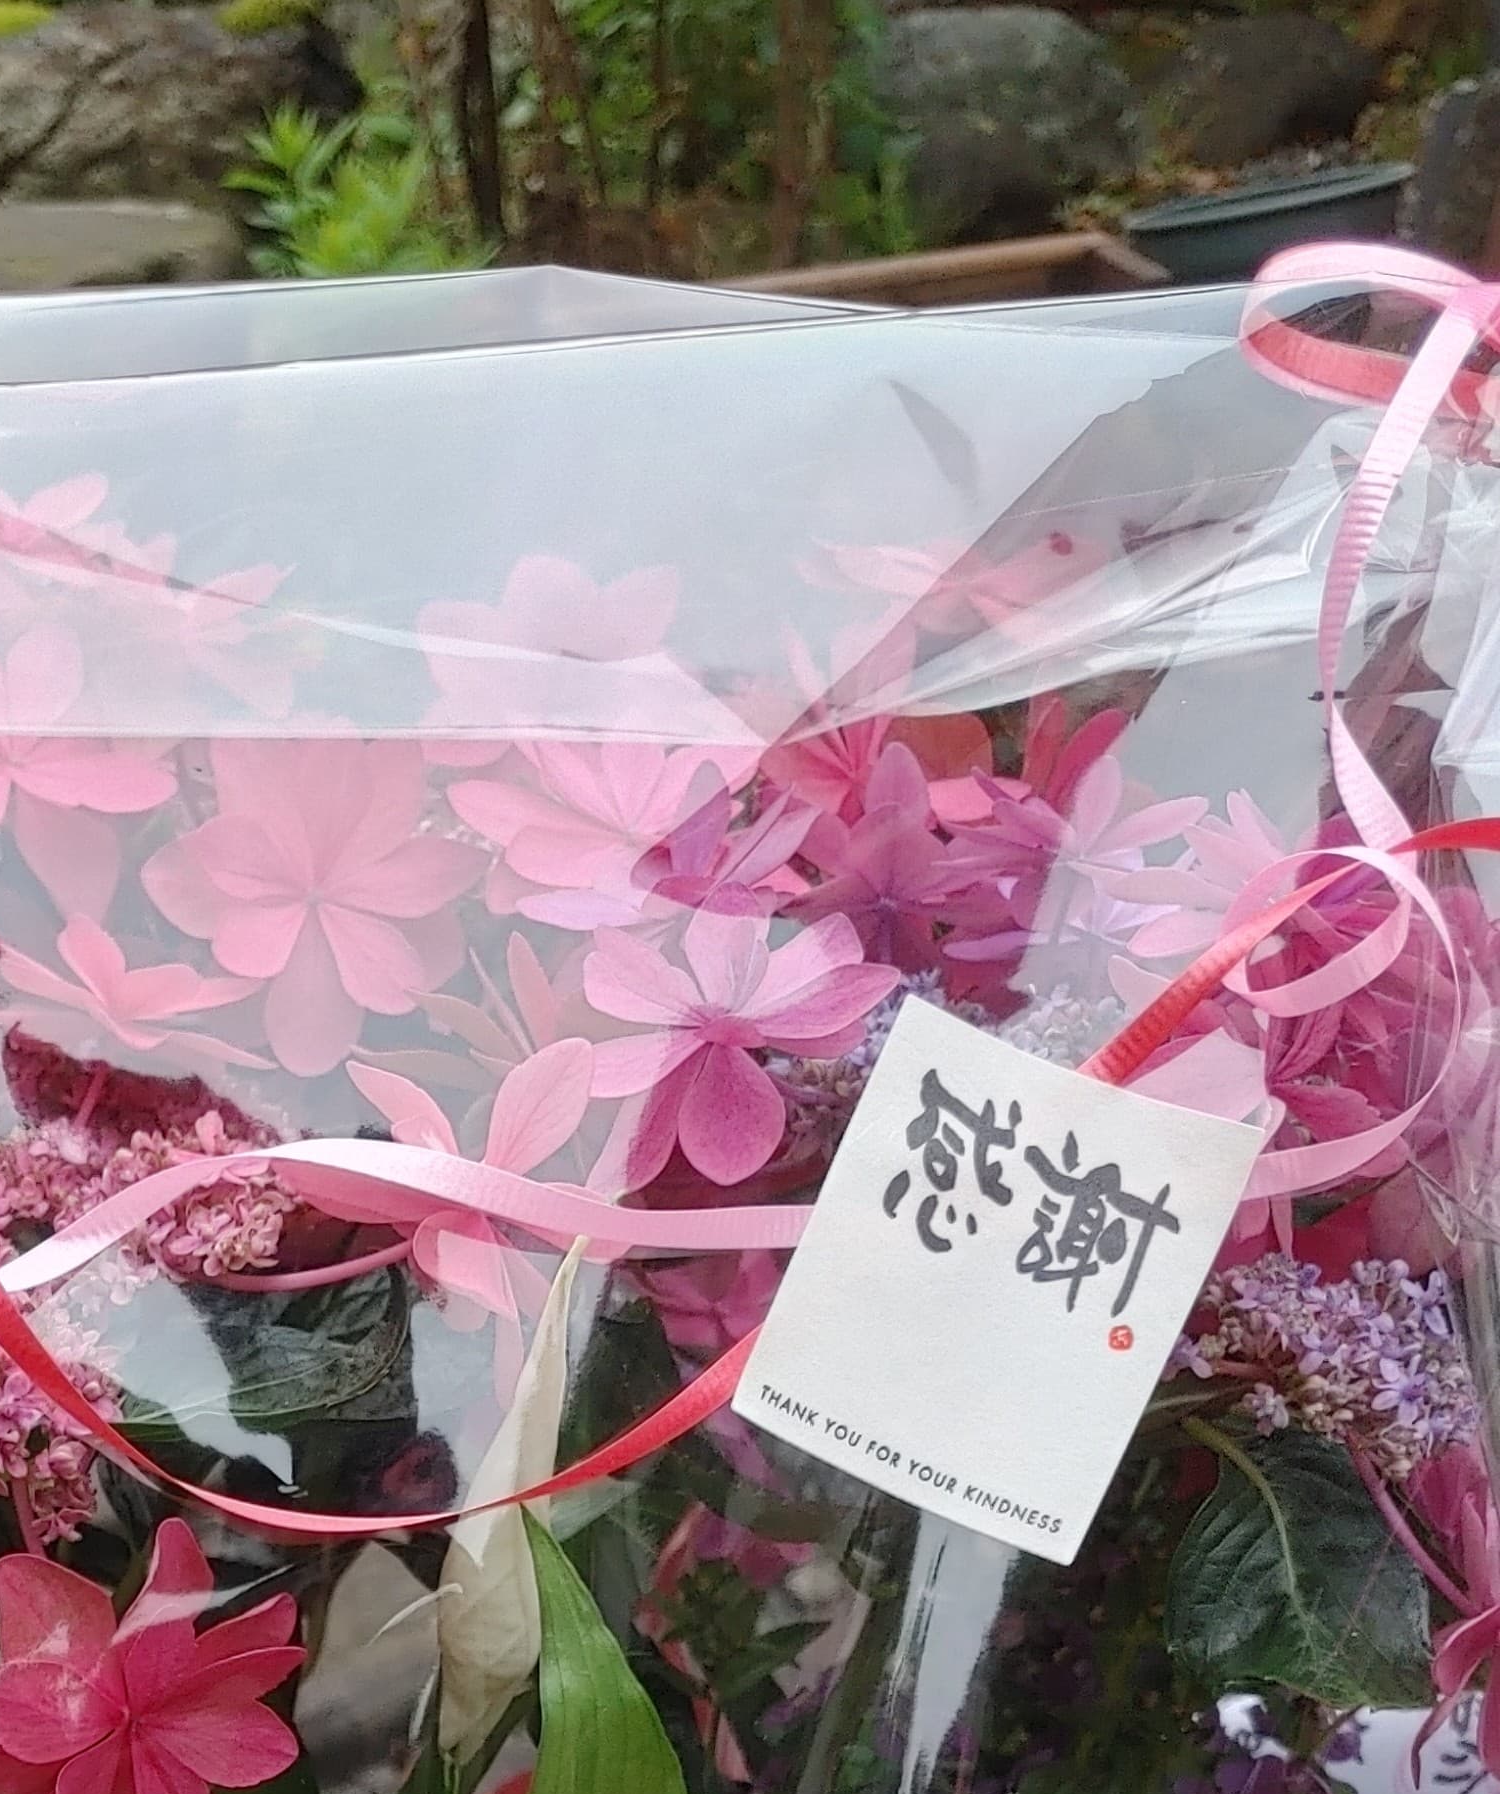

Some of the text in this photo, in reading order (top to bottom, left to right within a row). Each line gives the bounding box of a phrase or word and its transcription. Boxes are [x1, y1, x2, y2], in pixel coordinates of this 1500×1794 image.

[882, 1068, 1180, 1317] 感謝
[759, 1385, 1063, 1534] THANK YOU FOR YOUR KINDNESS
